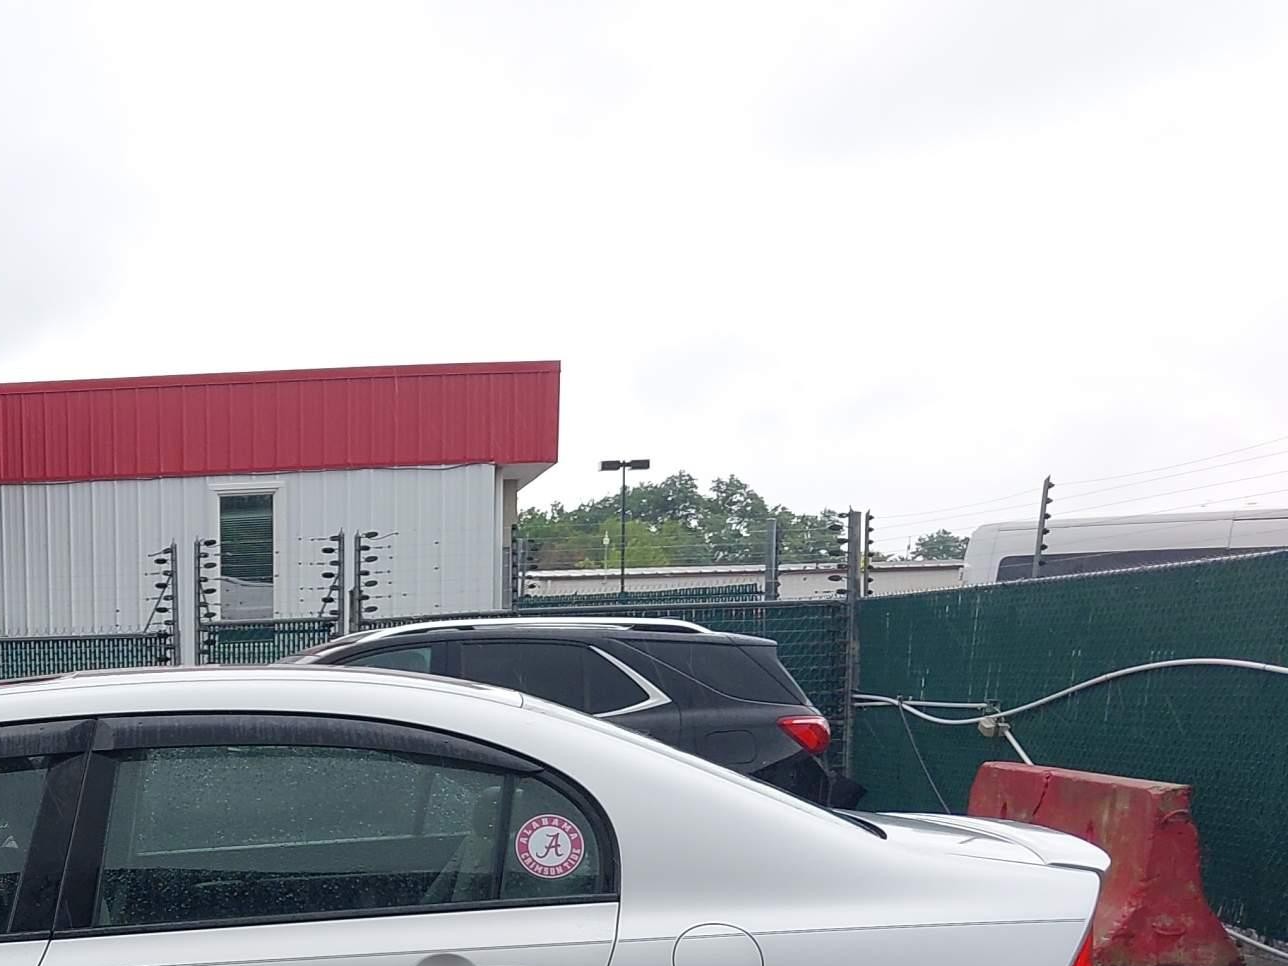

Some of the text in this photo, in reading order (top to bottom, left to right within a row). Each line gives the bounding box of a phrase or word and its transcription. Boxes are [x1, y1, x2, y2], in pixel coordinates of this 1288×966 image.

[520, 818, 578, 844] ALABAMA
[535, 832, 564, 859] A
[520, 848, 581, 875] CRIMSON TIDE
